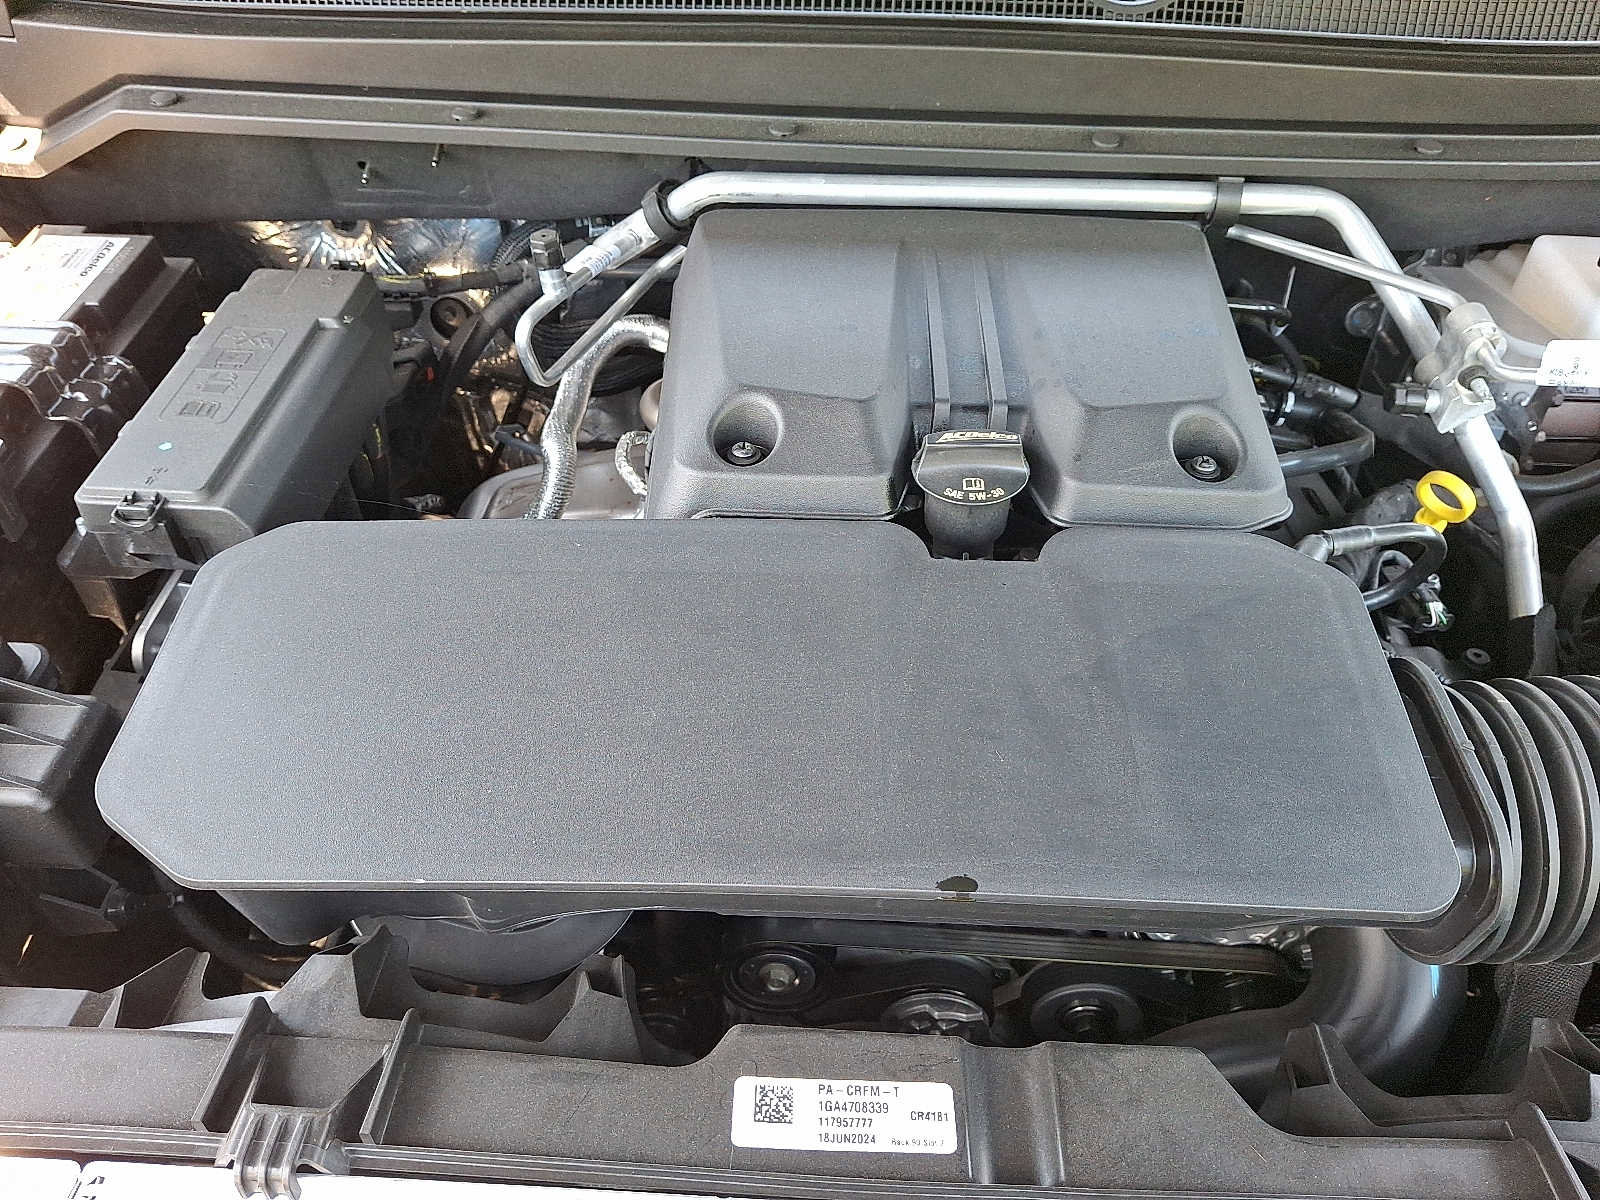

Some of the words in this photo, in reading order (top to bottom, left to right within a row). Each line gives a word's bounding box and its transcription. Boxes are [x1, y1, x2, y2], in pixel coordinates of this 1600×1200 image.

[935, 430, 1018, 443] ACDelco
[943, 487, 965, 500] SAE
[968, 487, 1005, 501] 5W-30
[818, 1100, 889, 1114] 1GA4708339
[818, 1116, 873, 1128] 117957777
[818, 1132, 876, 1144] 18JUN2024
